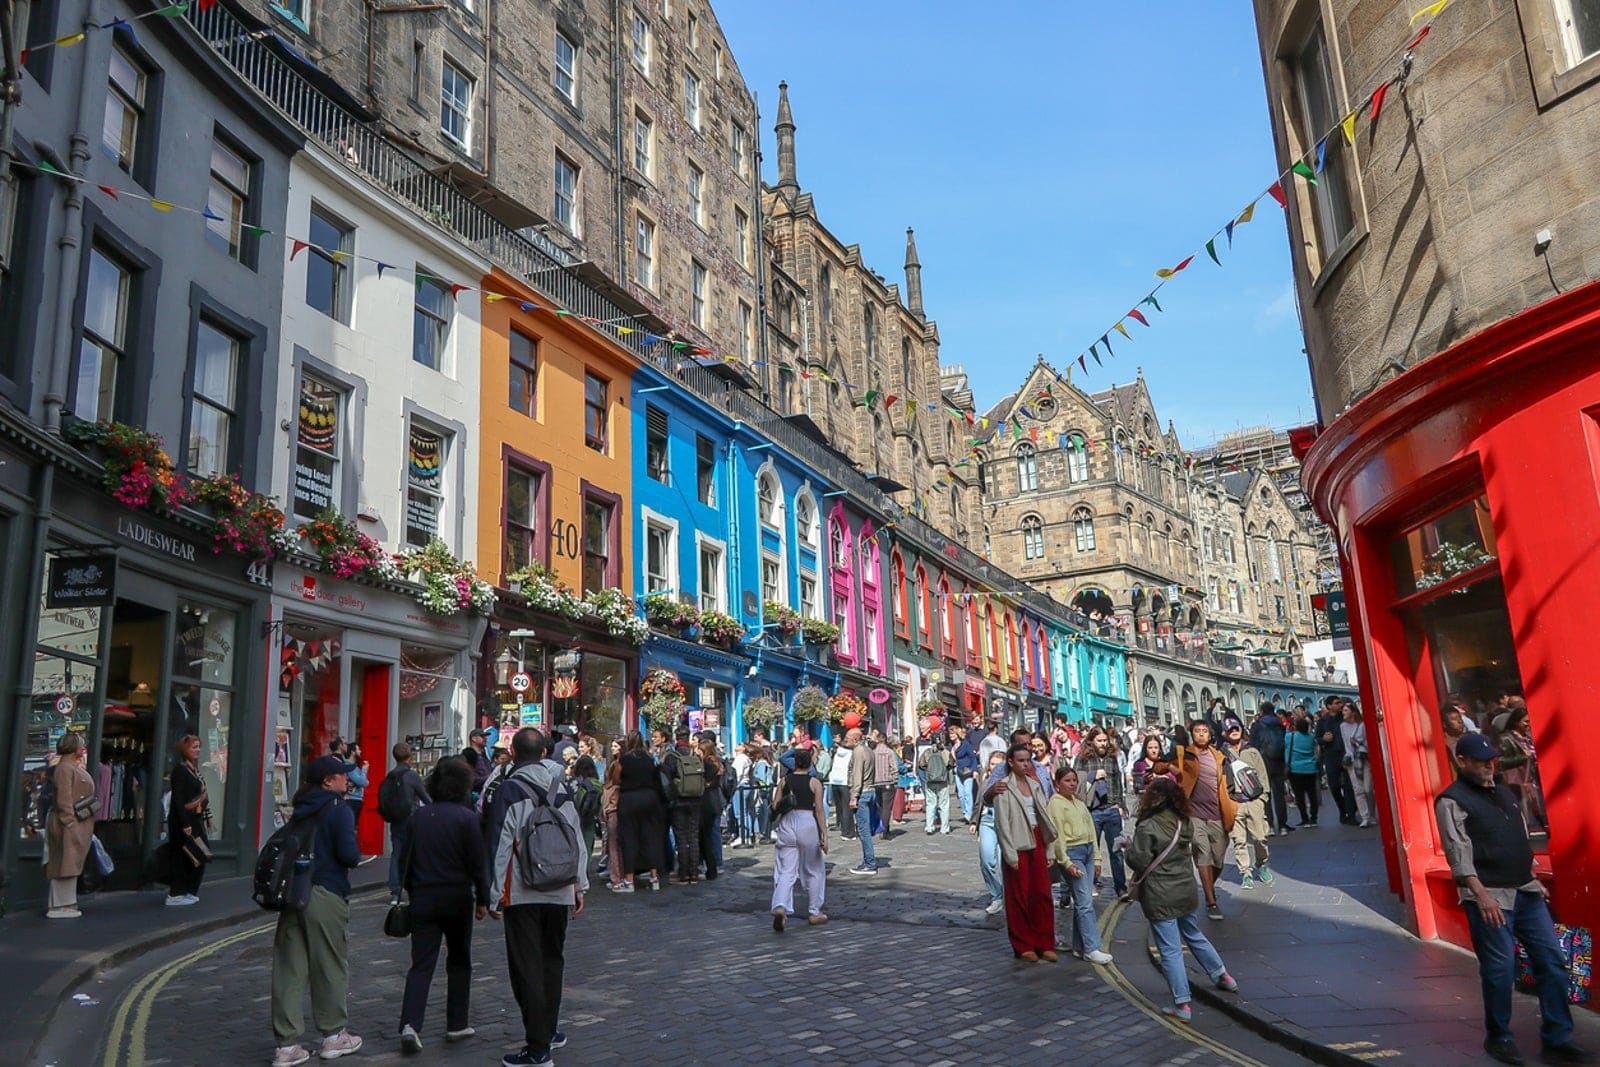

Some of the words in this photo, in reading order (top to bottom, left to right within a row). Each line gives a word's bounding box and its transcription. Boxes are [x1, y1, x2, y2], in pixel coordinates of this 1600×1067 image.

[117, 517, 196, 562] LADIESWEAR
[551, 518, 579, 560] 40
[290, 579, 304, 594] the
[317, 587, 336, 601] door
[338, 593, 366, 611] gallery
[513, 677, 528, 688] 20
